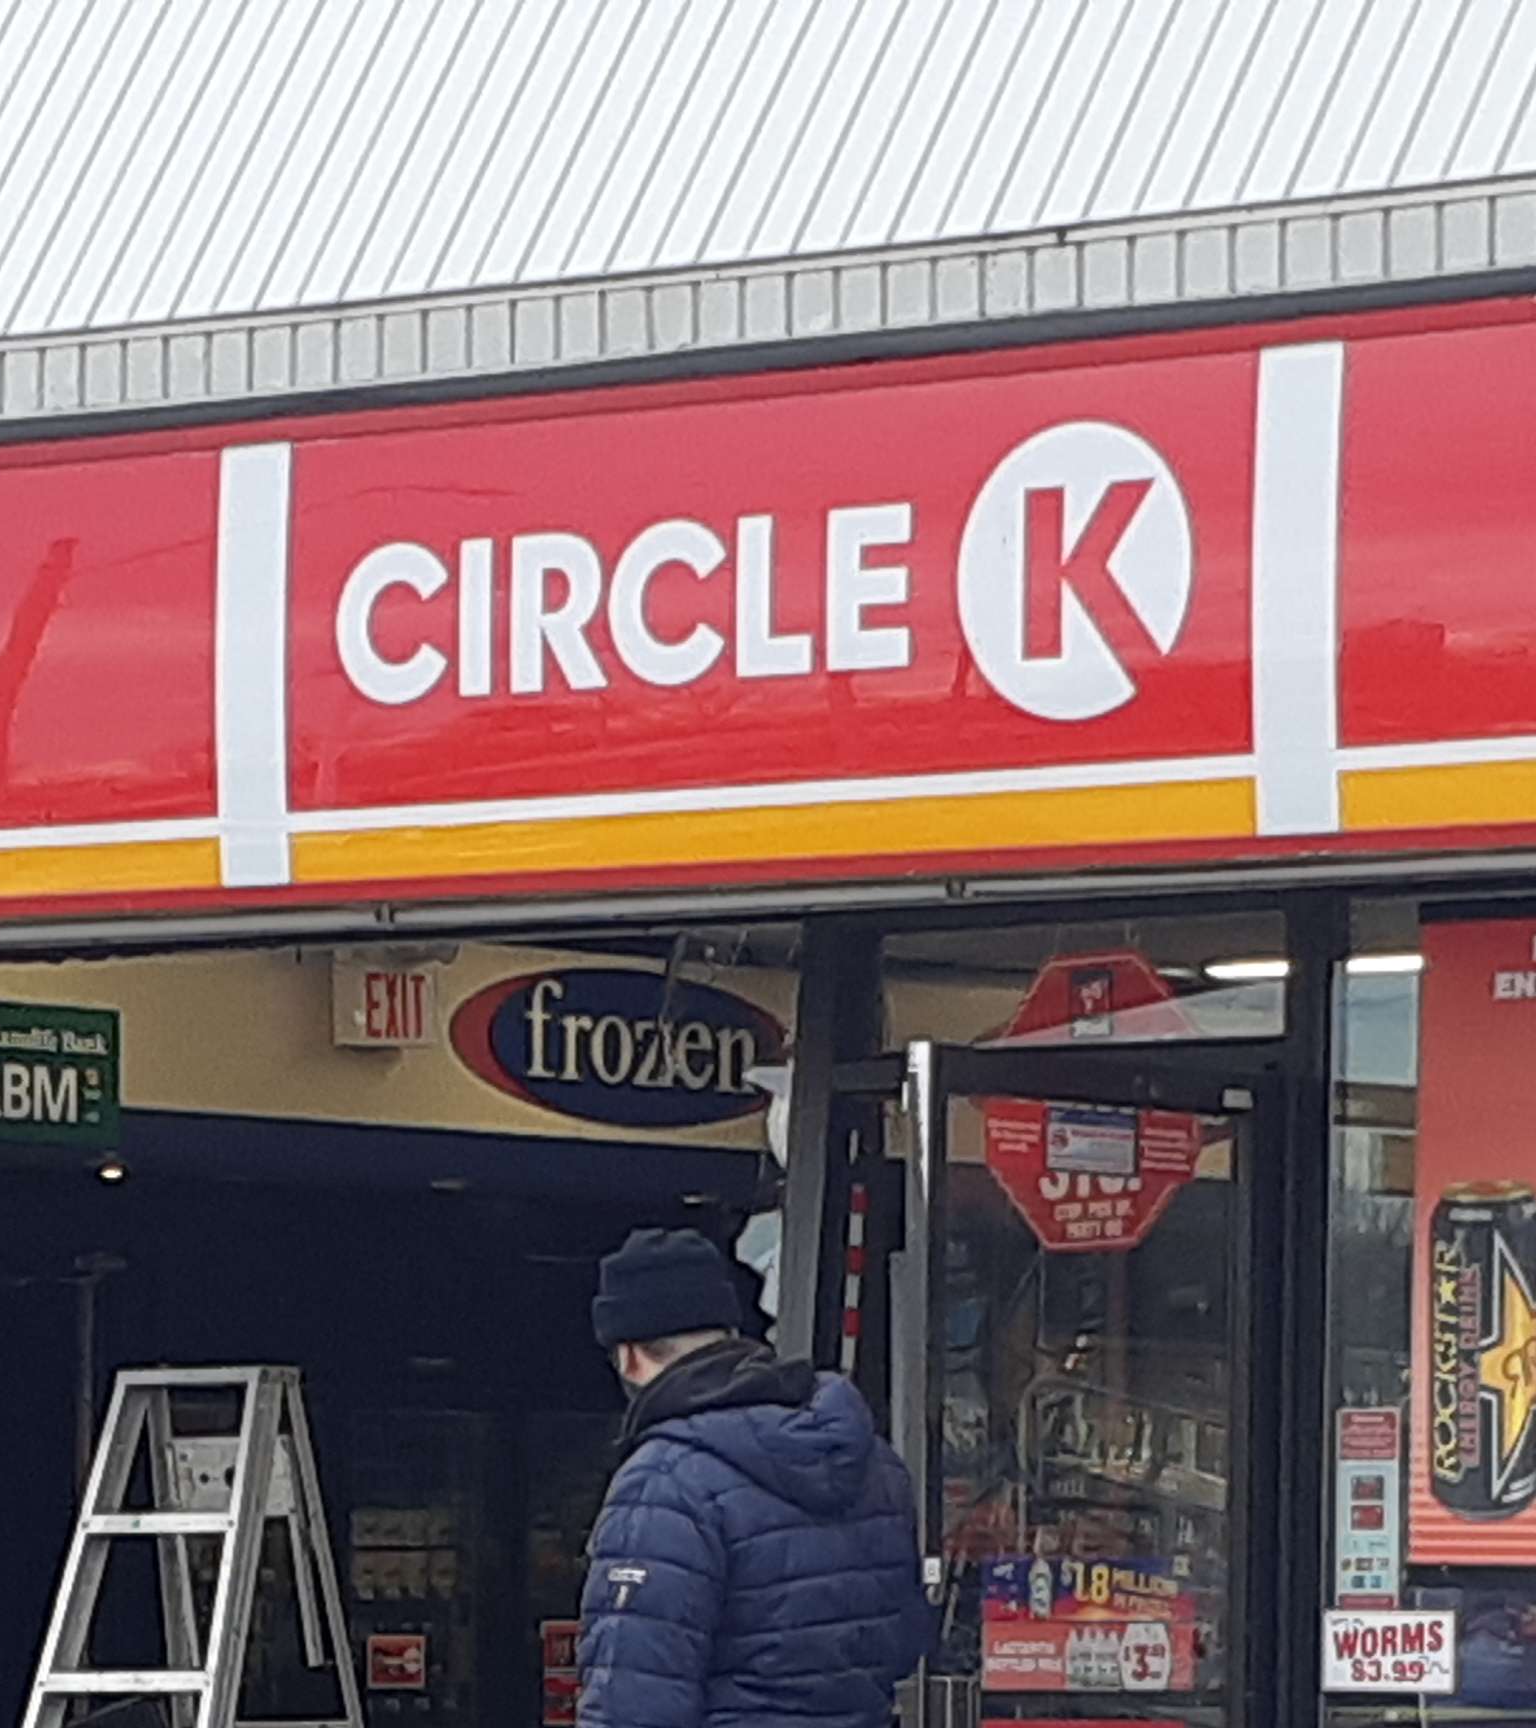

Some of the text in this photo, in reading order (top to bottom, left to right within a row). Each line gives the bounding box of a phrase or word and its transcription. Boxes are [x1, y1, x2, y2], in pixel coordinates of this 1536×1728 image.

[335, 470, 1179, 706] CIRCLE K
[365, 972, 426, 1039] EXIT
[61, 1030, 107, 1055] Bank
[523, 977, 758, 1095] frozen
[1332, 1620, 1444, 1660] WORMS
[1351, 1658, 1425, 1683] $3.99
